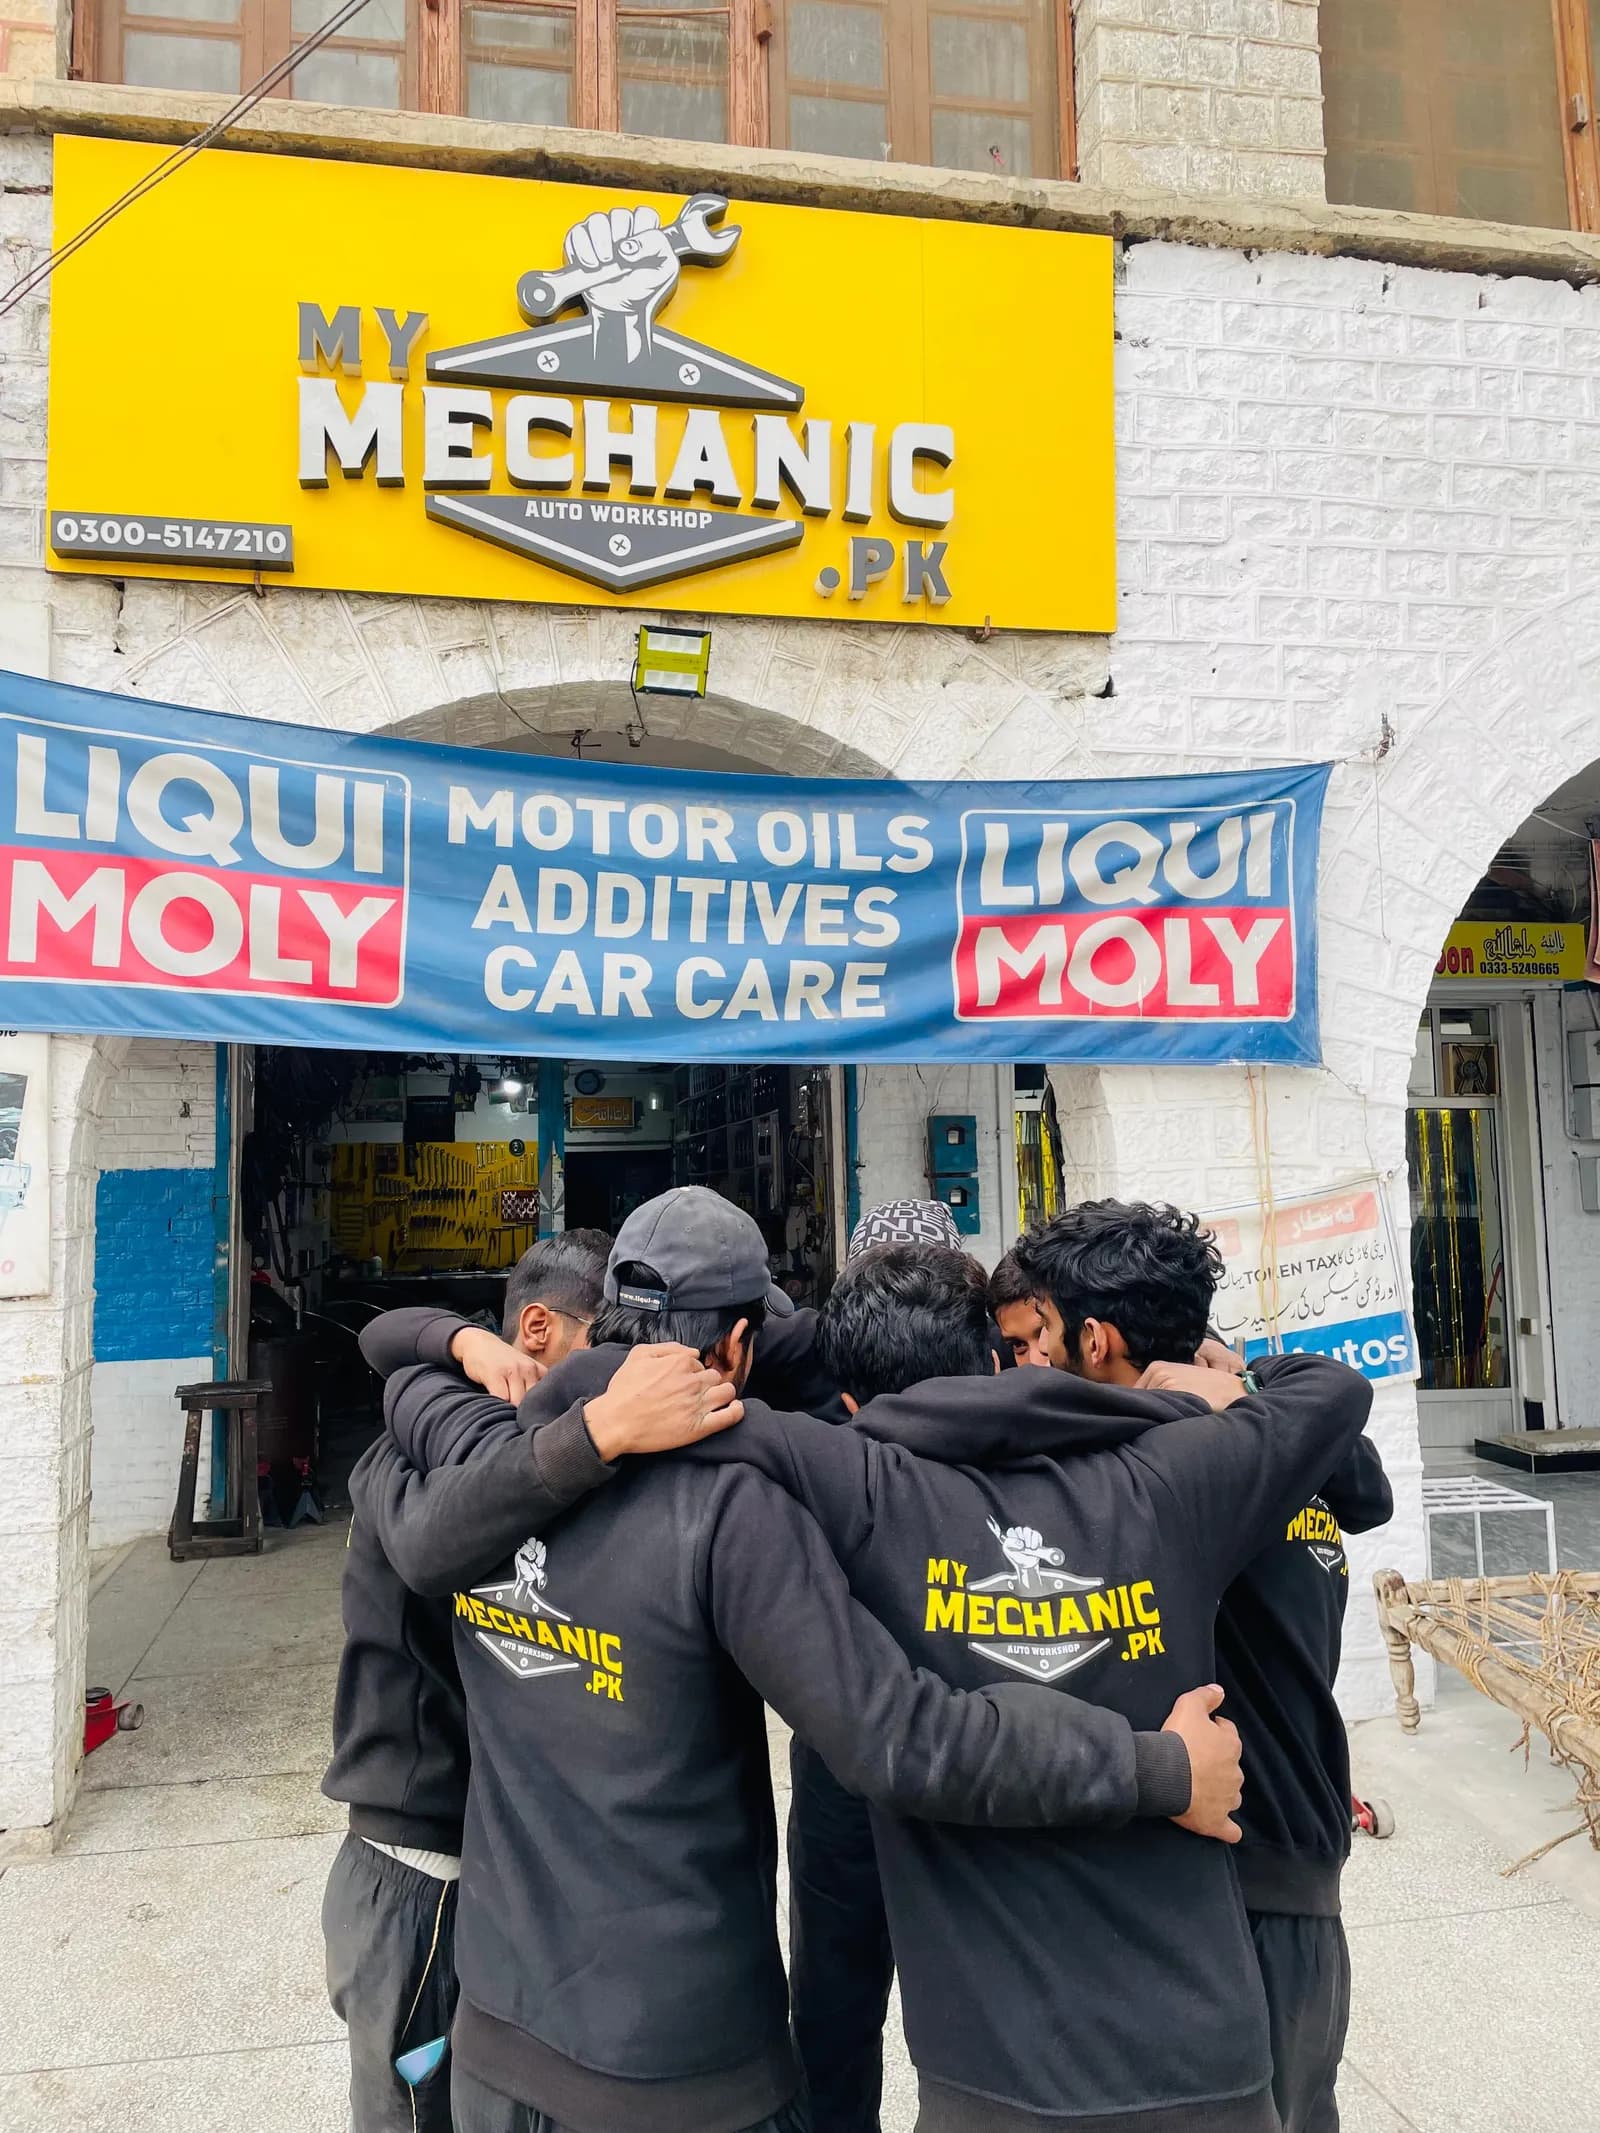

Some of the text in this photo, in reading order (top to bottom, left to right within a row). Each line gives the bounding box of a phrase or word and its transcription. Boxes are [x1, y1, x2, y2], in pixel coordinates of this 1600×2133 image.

[298, 302, 430, 376] MY
[299, 378, 955, 527] MECHANIC
[56, 518, 287, 553] 0300-5147210
[525, 500, 713, 529] AUTO WORKSHOP
[814, 536, 951, 602] .PK
[15, 733, 385, 874] LIQUI
[448, 786, 934, 873] MOTOR OILS
[980, 811, 1275, 906] LIQUI
[8, 860, 395, 988] MOLY
[472, 864, 900, 947] ADDITIVES
[484, 945, 886, 1021] CAR CARE
[976, 916, 1283, 1008] MOLY
[1480, 962, 1560, 975] 0333-5249665
[1306, 1254, 1338, 1273] TAX
[1291, 1334, 1408, 1370] tos
[927, 1558, 968, 1587] MY
[453, 1592, 623, 1675] MECHANIC
[924, 1580, 1160, 1638] MECHANIC
[500, 1639, 554, 1661] AUTO WORKSHOP
[1007, 1643, 1080, 1656] AUTO WORKSHOP
[1120, 1627, 1166, 1661] .PK
[585, 1670, 624, 1702] .PK
